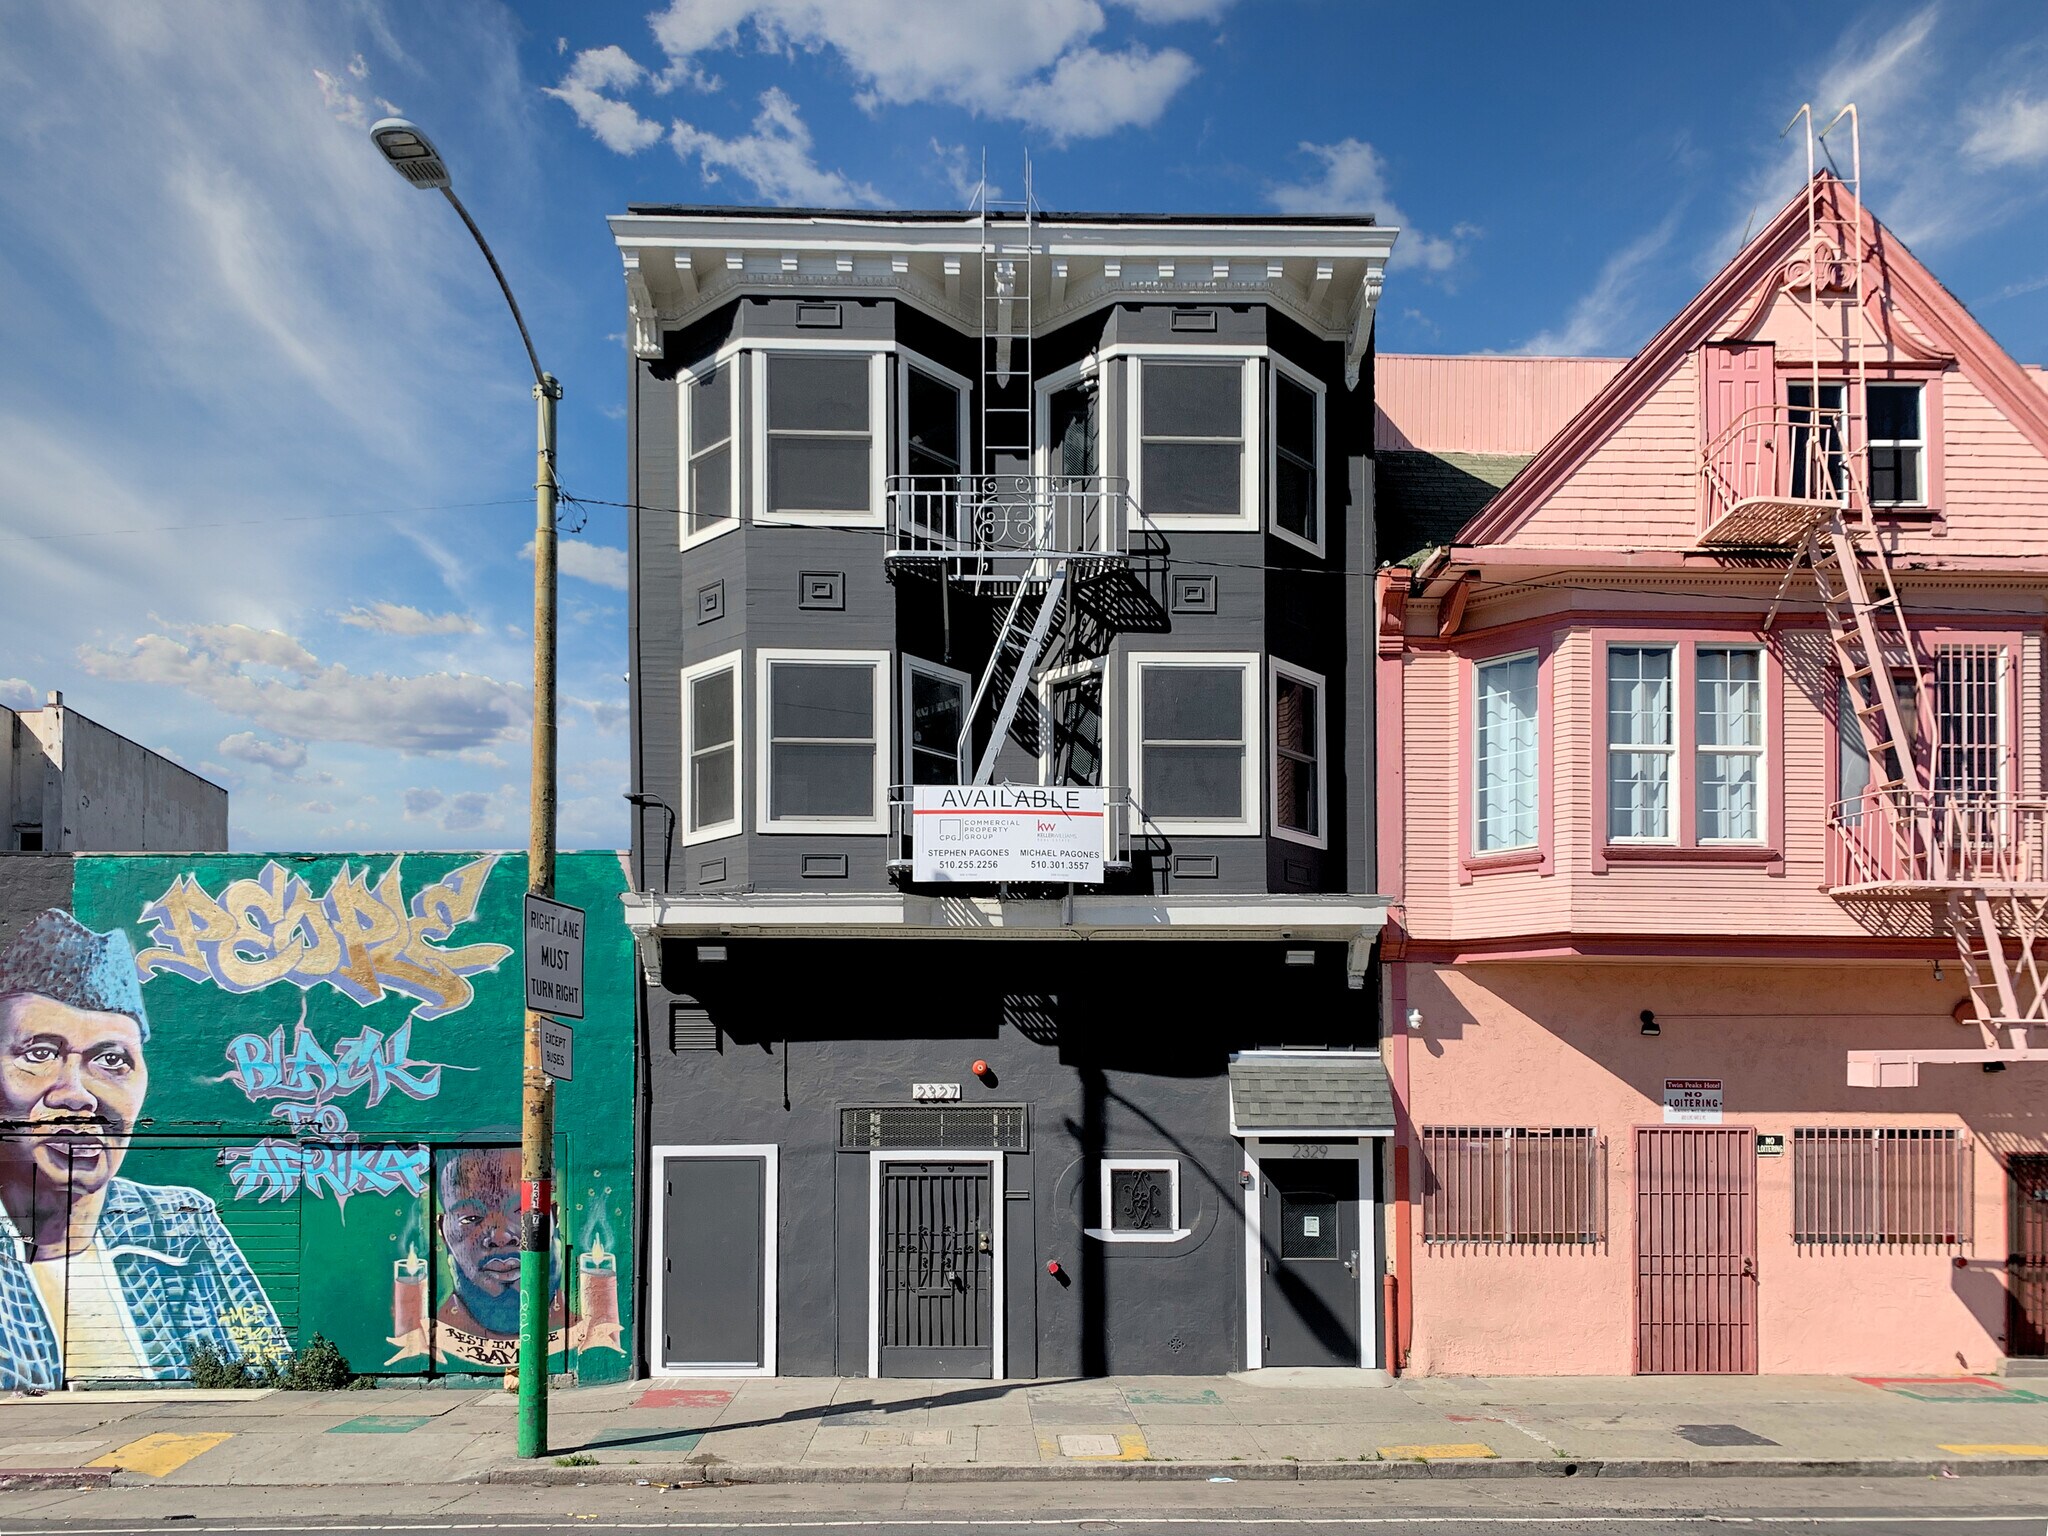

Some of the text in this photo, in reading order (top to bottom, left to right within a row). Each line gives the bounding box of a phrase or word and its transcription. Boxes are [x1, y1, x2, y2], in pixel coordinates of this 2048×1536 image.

[941, 789, 1080, 809] AVAILABLE
[1037, 819, 1056, 832] kw
[927, 849, 1010, 857] STEPHEN PAGONES
[1020, 849, 1100, 859] MICHAEL PAGONES
[939, 860, 998, 869] 510.255.2256
[1031, 860, 1089, 870] 510.301.3557
[530, 910, 580, 940] RIGHT LANE
[136, 854, 514, 1021] PEOPLE
[541, 945, 569, 971] MUST
[531, 978, 579, 1004] TURN RIGHT
[545, 1032, 567, 1050] EXCEPT
[226, 1016, 441, 1109] BLACK
[546, 1050, 565, 1067] BUSES
[915, 1085, 958, 1099] 2327
[1668, 1099, 1718, 1107] LOITERING
[1765, 1136, 1775, 1145] NO
[1292, 1145, 1328, 1159] 2329
[1757, 1144, 1783, 1153] LOITERING
[445, 1328, 515, 1350] REST IN
